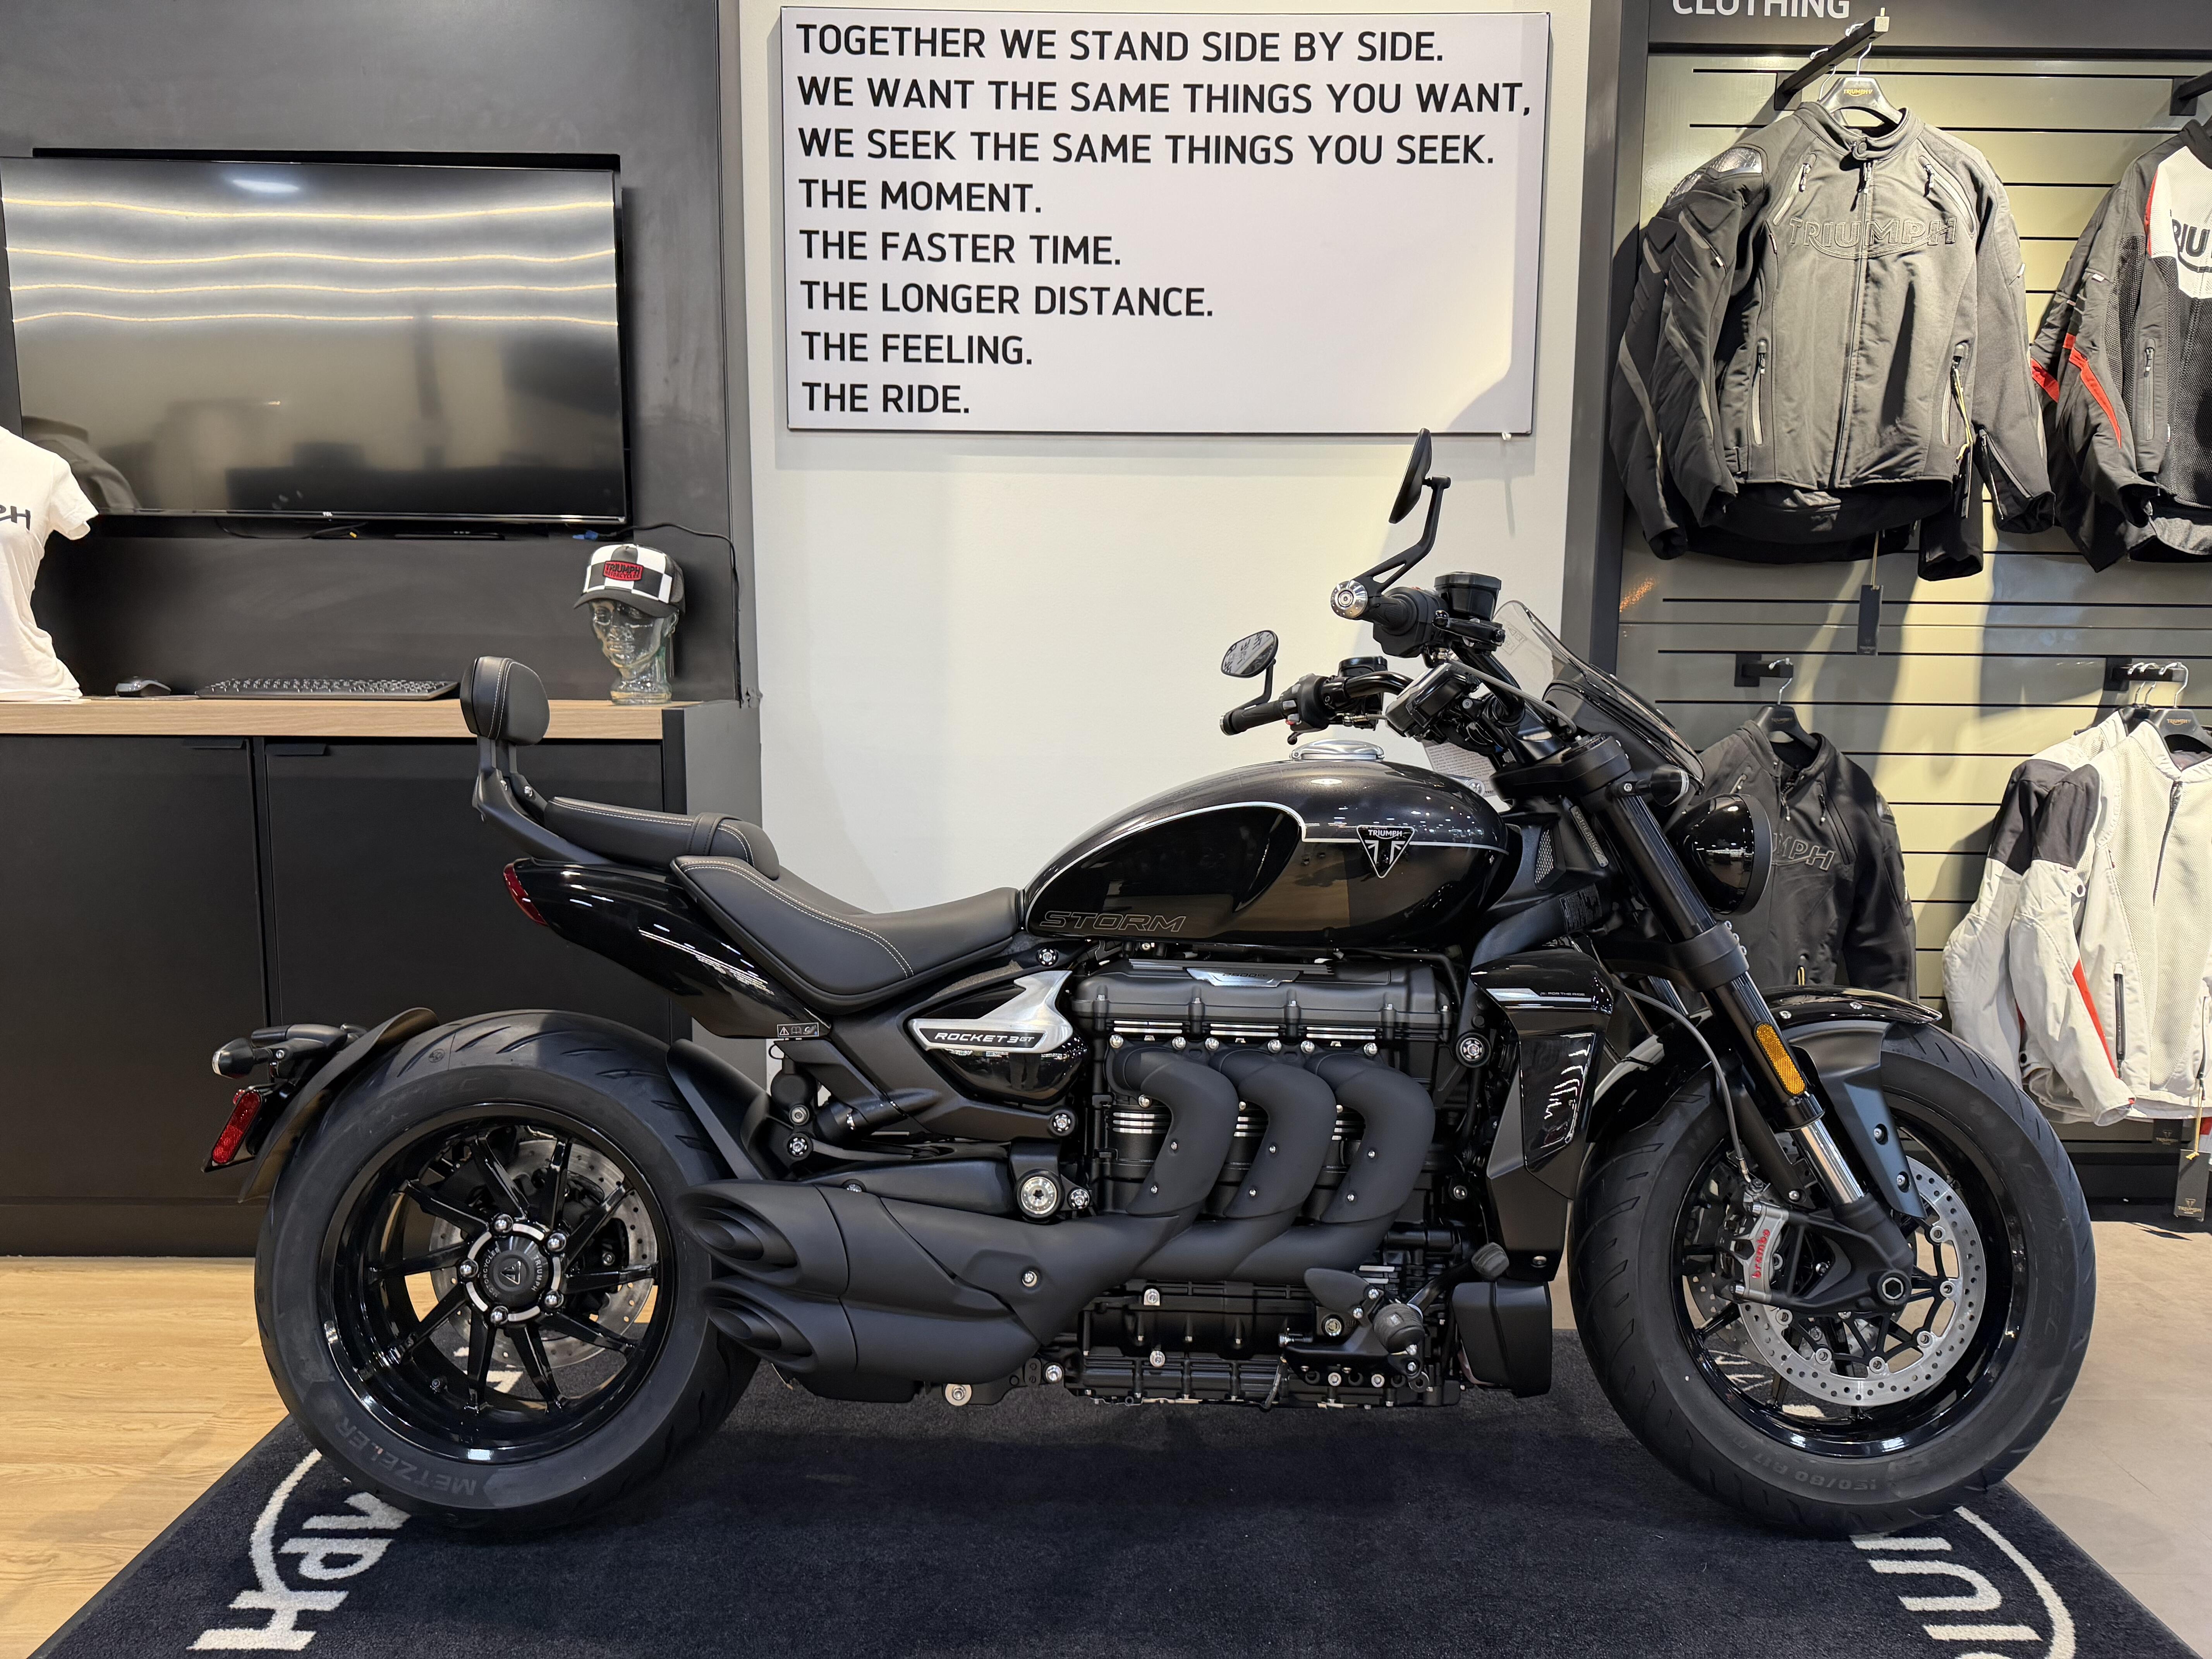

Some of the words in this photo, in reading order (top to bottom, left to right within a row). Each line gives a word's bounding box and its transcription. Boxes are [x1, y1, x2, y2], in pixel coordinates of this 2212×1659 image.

[795, 23, 986, 58] TOGETHER
[1000, 29, 1056, 60] WE
[1070, 29, 1188, 61] STAND
[1202, 31, 1280, 62] SIDE
[1294, 31, 1344, 62] BY
[1357, 31, 1443, 62] SIDE.
[797, 76, 854, 106] WE
[866, 77, 975, 109] WANT
[988, 80, 1057, 111] THE
[1070, 81, 1170, 113] SAME
[1183, 83, 1312, 114] THINGS
[1326, 83, 1401, 113] YOU
[1415, 82, 1530, 117] WANT,
[797, 127, 854, 158] WE
[867, 129, 957, 160] SEEK
[970, 131, 1039, 162] THE
[1053, 132, 1151, 163] SAME
[1164, 134, 1293, 165] THINGS
[1307, 134, 1382, 165] YOU
[1396, 134, 1494, 165] SEEK.
[798, 178, 867, 210] THE
[881, 180, 1041, 213] MOMENT.
[799, 229, 867, 261] THE
[881, 232, 1015, 264] FASTER
[1029, 235, 1121, 265] TIME.
[1789, 216, 1958, 259] TRIUMPH
[800, 280, 868, 311] THE
[882, 282, 1020, 314] LONGER
[1035, 285, 1213, 317] DISTANCE.
[800, 331, 869, 362] THE
[882, 333, 1032, 365] FEELING.
[802, 381, 869, 413] THE
[882, 384, 969, 414] RIDE.
[606, 563, 641, 574] TRIUMPH
[1368, 829, 1403, 839] TRIUMPH
[1039, 910, 1187, 932] STORM
[531, 1254, 543, 1291] TRIUMPH
[335, 1416, 477, 1496] METZELER
